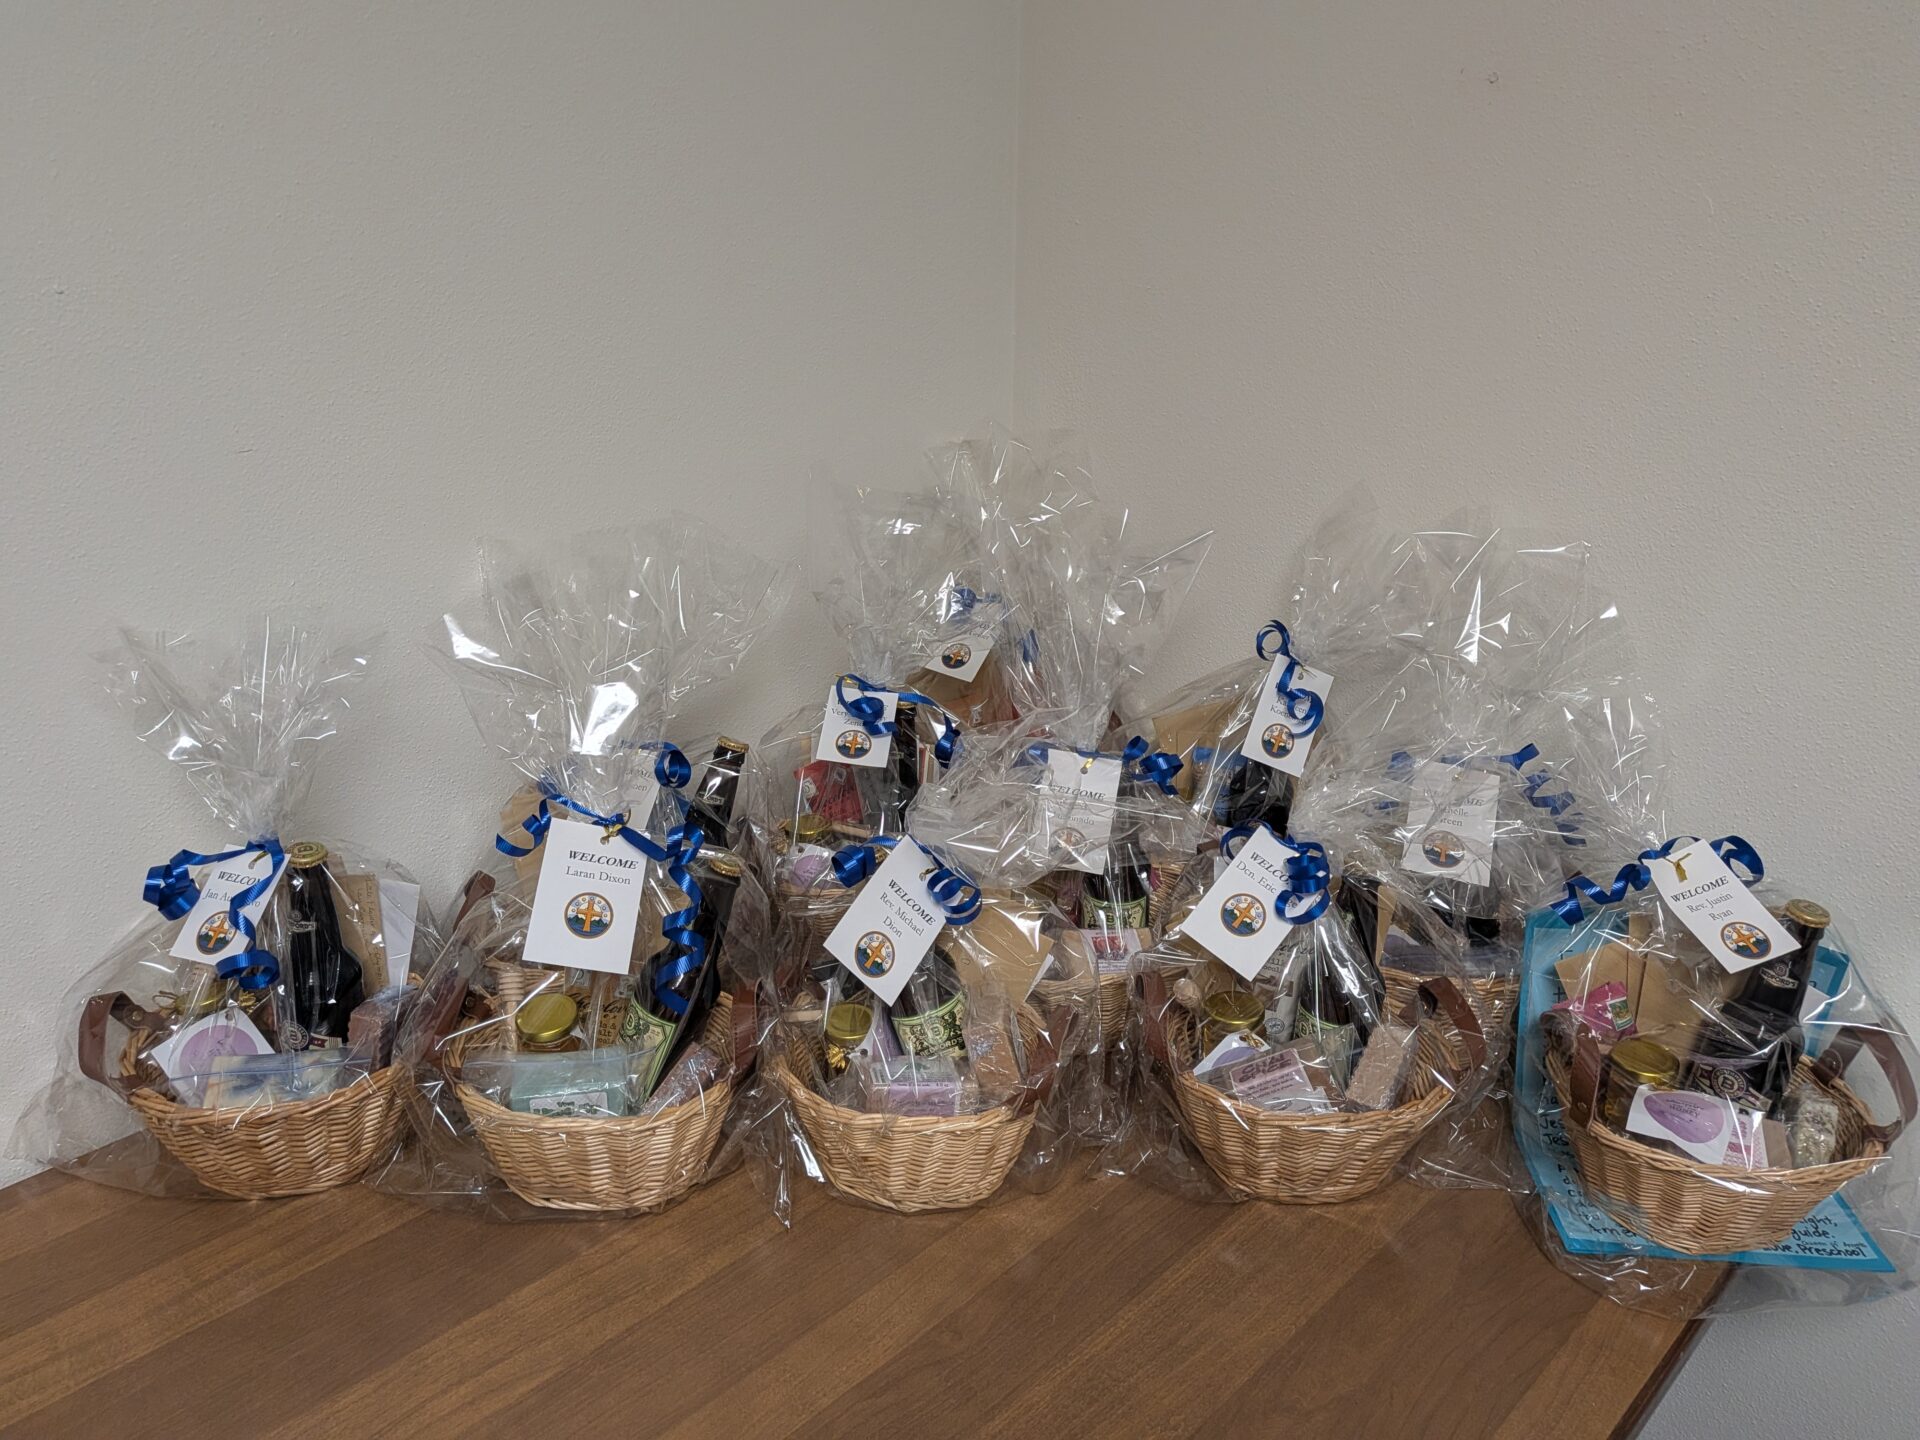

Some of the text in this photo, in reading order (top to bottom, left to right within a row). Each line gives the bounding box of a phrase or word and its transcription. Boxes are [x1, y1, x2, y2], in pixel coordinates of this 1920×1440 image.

[568, 849, 639, 871] WELCOME
[1250, 851, 1290, 885] WELCO
[218, 870, 261, 886] WELCO
[565, 865, 632, 886] Laran Dixon
[1236, 860, 1256, 881] Dcn.
[1257, 876, 1277, 894] Eric
[202, 888, 219, 901] Jan
[1671, 875, 1730, 903] WELCOME
[888, 879, 937, 926] WELCOME
[1687, 891, 1733, 913] Rev. Justin
[879, 891, 925, 937] Rev. Michael
[1709, 908, 1734, 922] Ryan
[884, 916, 903, 938] Dion
[1542, 1134, 1569, 1147] Jes
[1799, 1243, 1867, 1258] Preschool
